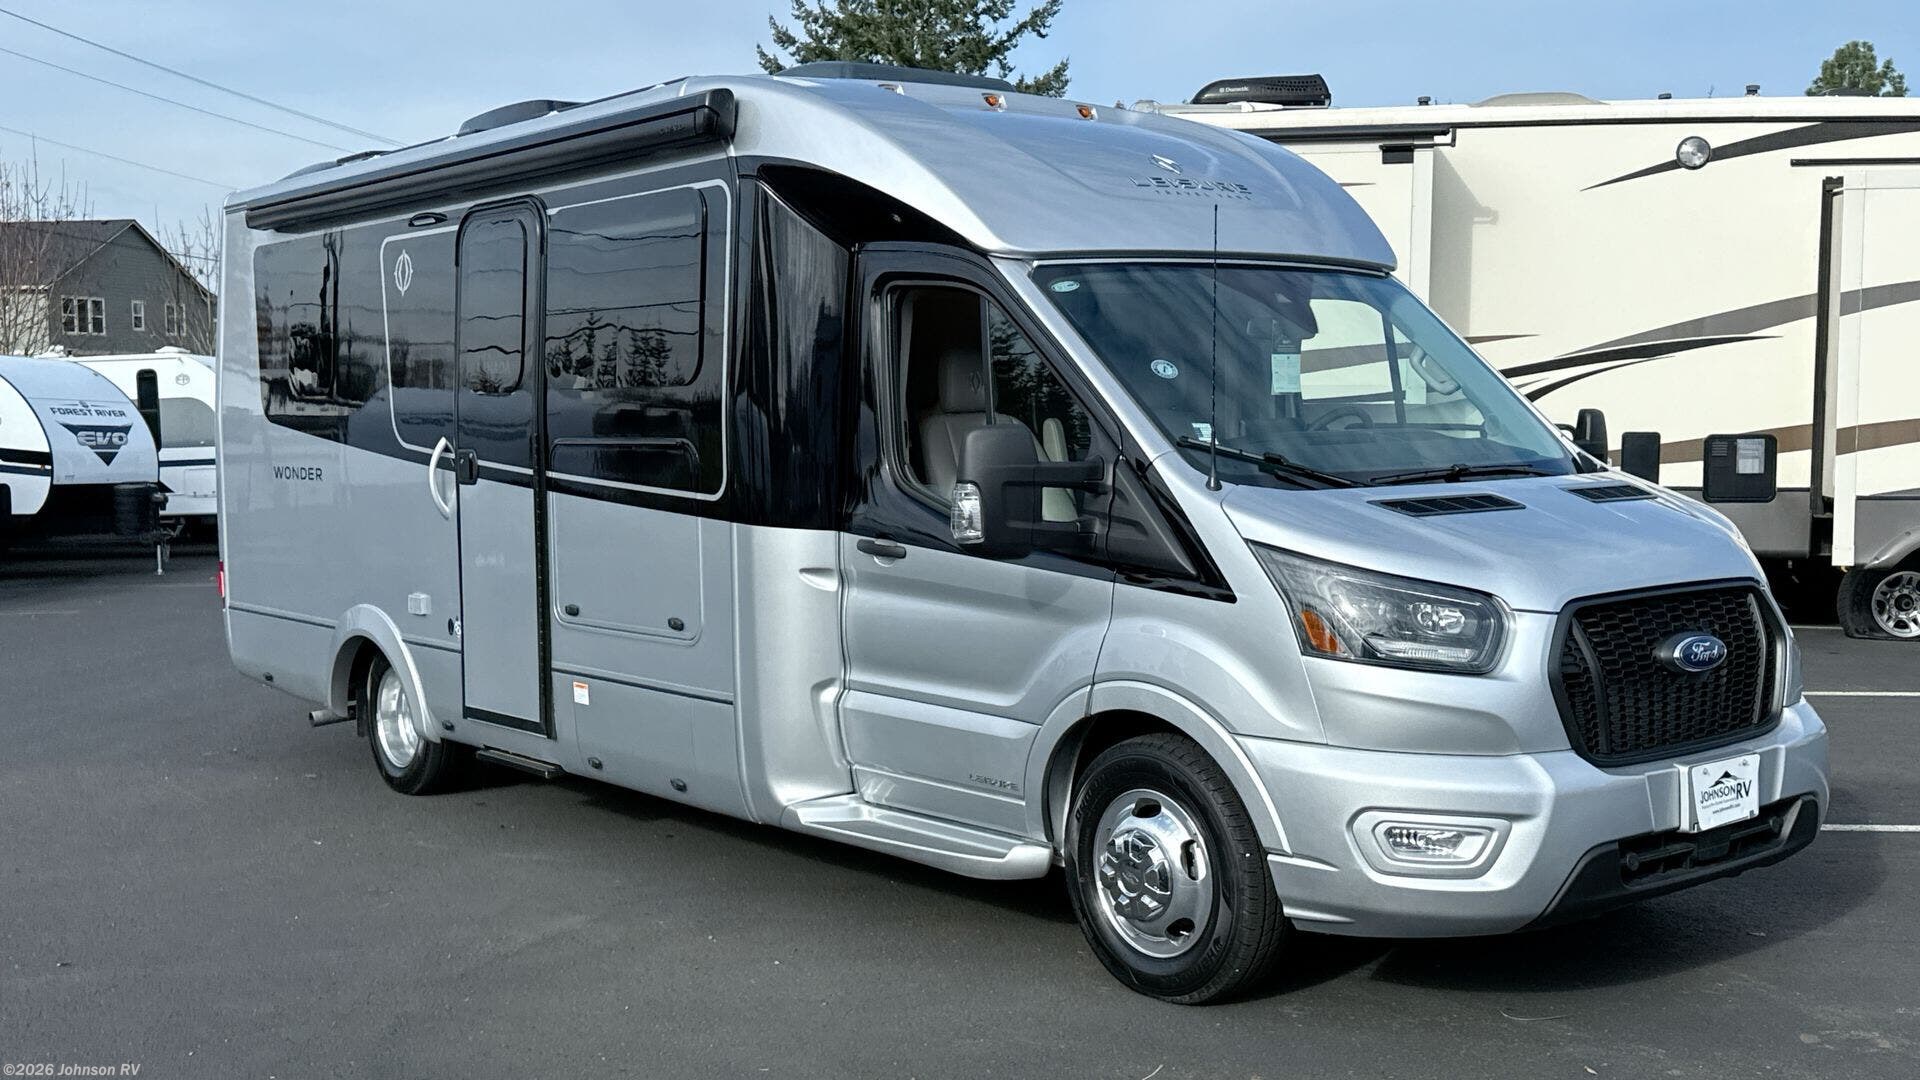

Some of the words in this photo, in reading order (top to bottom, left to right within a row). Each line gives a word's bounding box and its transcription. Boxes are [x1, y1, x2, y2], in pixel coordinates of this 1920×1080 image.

[50, 406, 93, 417] FOREST
[95, 408, 128, 418] RIVER
[77, 430, 128, 446] EVO
[273, 466, 323, 481] WONDER
[1691, 641, 1719, 662] Ford
[1700, 784, 1736, 804] JOHNSON
